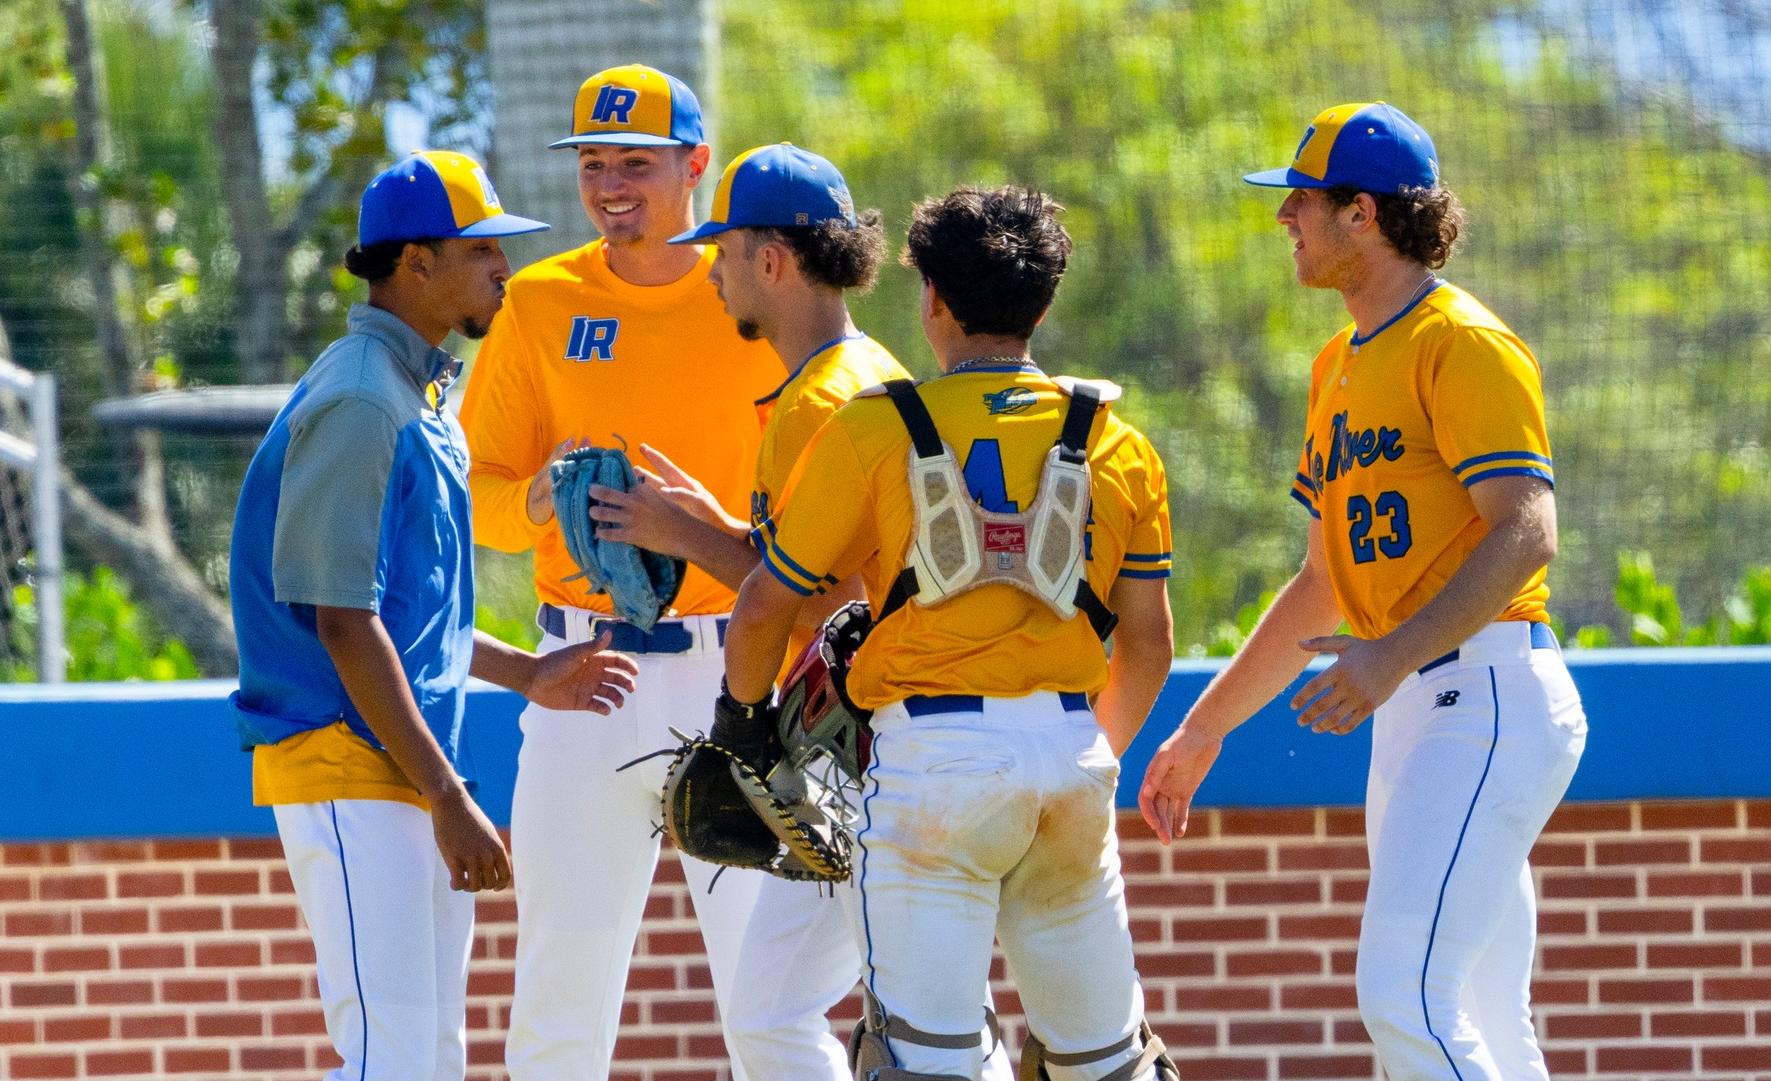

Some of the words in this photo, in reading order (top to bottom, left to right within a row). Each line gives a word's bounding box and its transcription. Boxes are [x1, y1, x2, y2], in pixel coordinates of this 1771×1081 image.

[589, 84, 639, 124] IR
[564, 316, 620, 361] IR
[1347, 490, 1413, 564] 23
